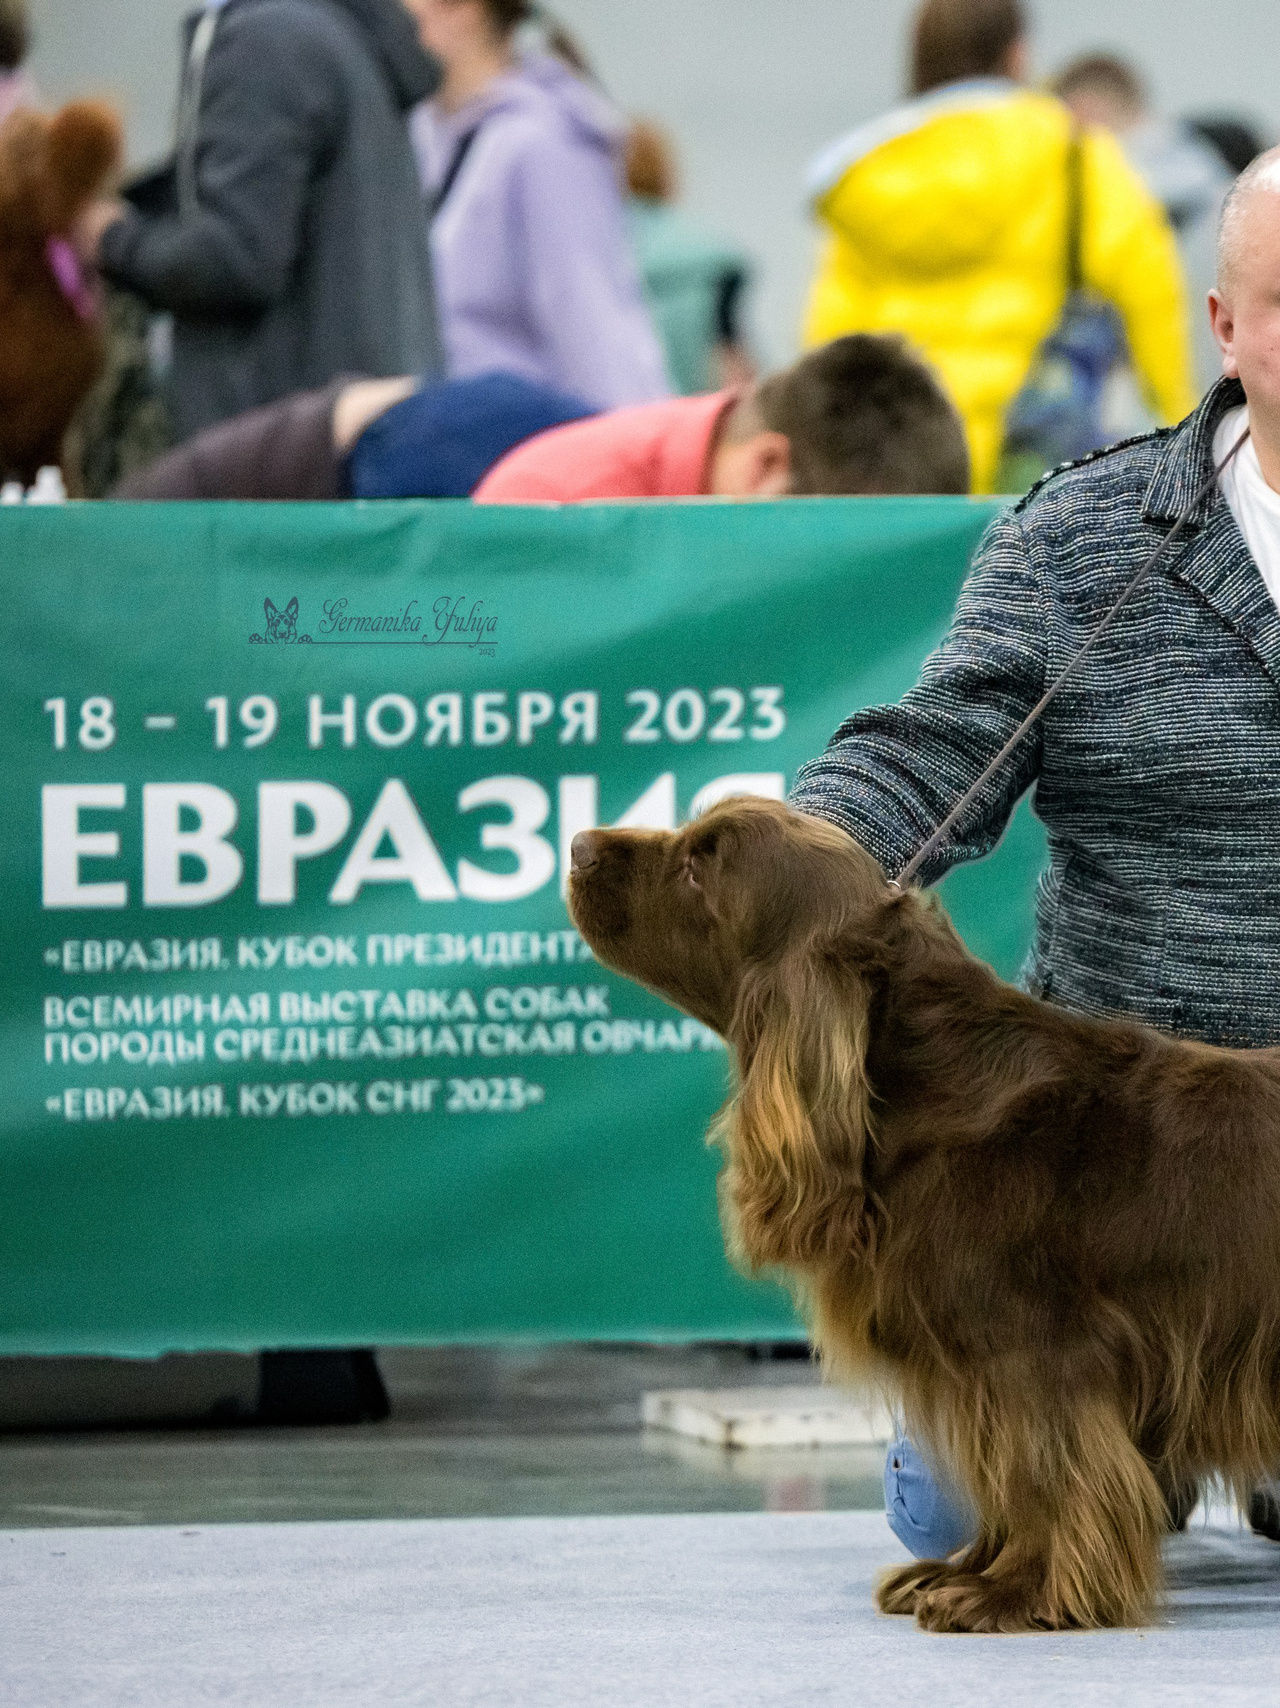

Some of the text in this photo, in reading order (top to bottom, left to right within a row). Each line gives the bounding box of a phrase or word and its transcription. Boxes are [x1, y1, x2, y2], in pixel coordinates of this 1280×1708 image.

[43, 696, 117, 750] 18
[204, 694, 279, 748] 19
[308, 690, 598, 748] НОЯБРЯ
[624, 686, 788, 742] 2023
[41, 772, 786, 907] ЕВРАЗИ
[237, 934, 359, 969] КУБОК
[43, 985, 611, 1028] ВСЕМИРНАЯ ВЫСТАВКА СОБАК
[43, 1028, 205, 1066] ПОРОДЫ
[213, 1020, 576, 1065] СРЕДНЕАЗИАТСКАЯ
[239, 1080, 360, 1117] КУБОК
[366, 1080, 441, 1114] СНГ
